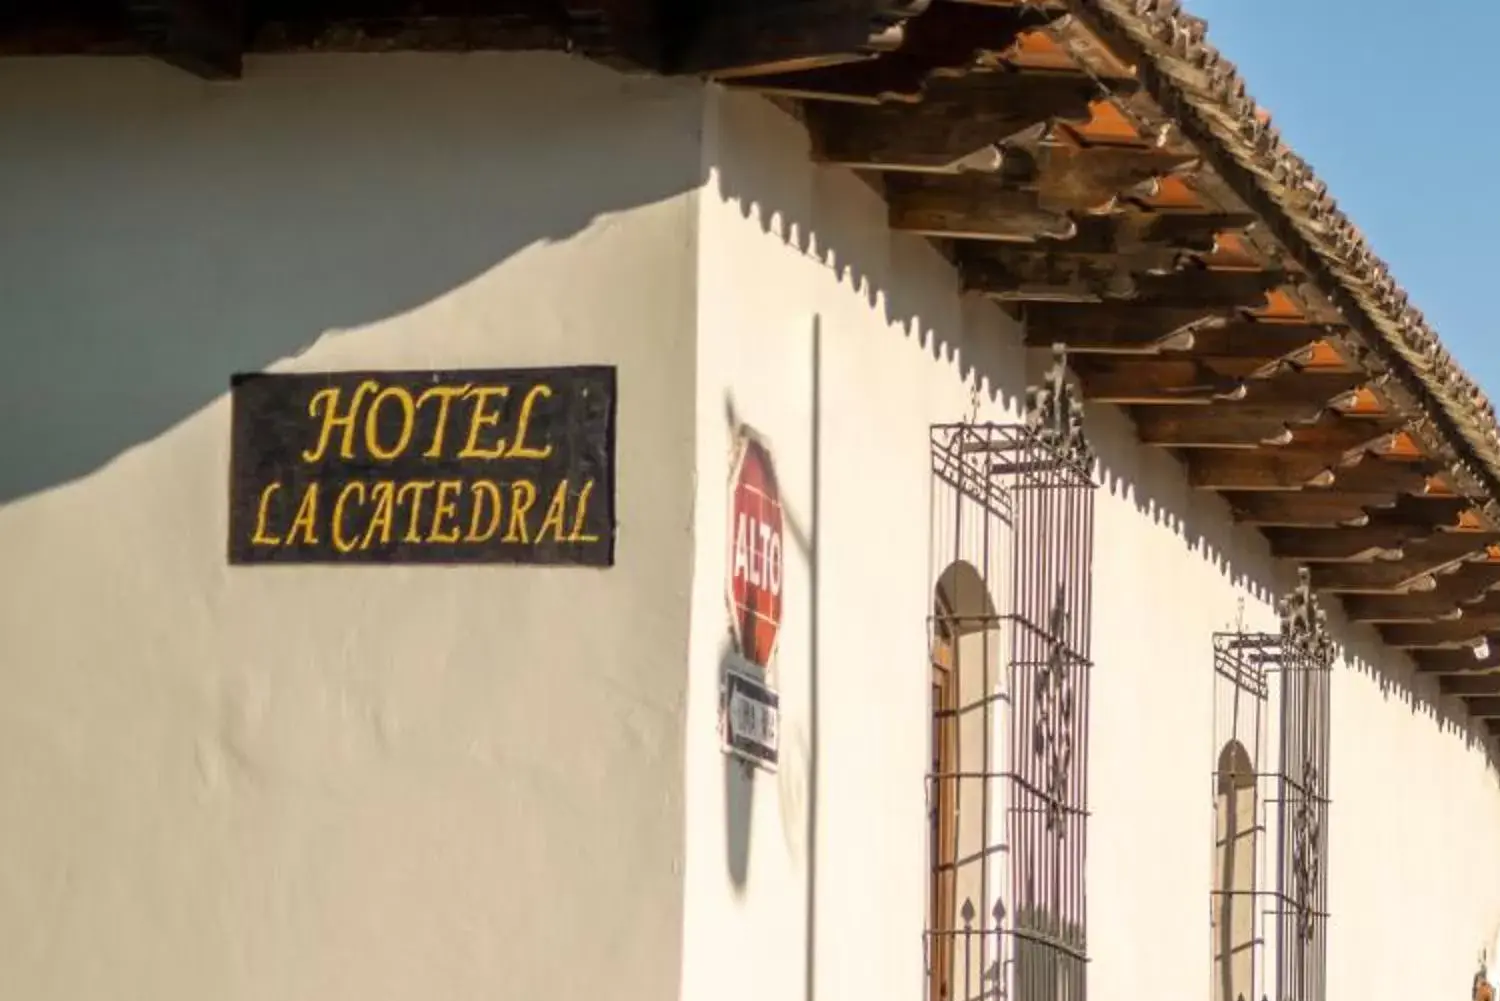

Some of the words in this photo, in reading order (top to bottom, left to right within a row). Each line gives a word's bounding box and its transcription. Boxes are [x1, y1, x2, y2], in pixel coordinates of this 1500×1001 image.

[302, 380, 552, 463] HOTEL
[252, 481, 319, 545] LA
[331, 479, 599, 552] CATEDRAL
[734, 511, 780, 597] ALTO
